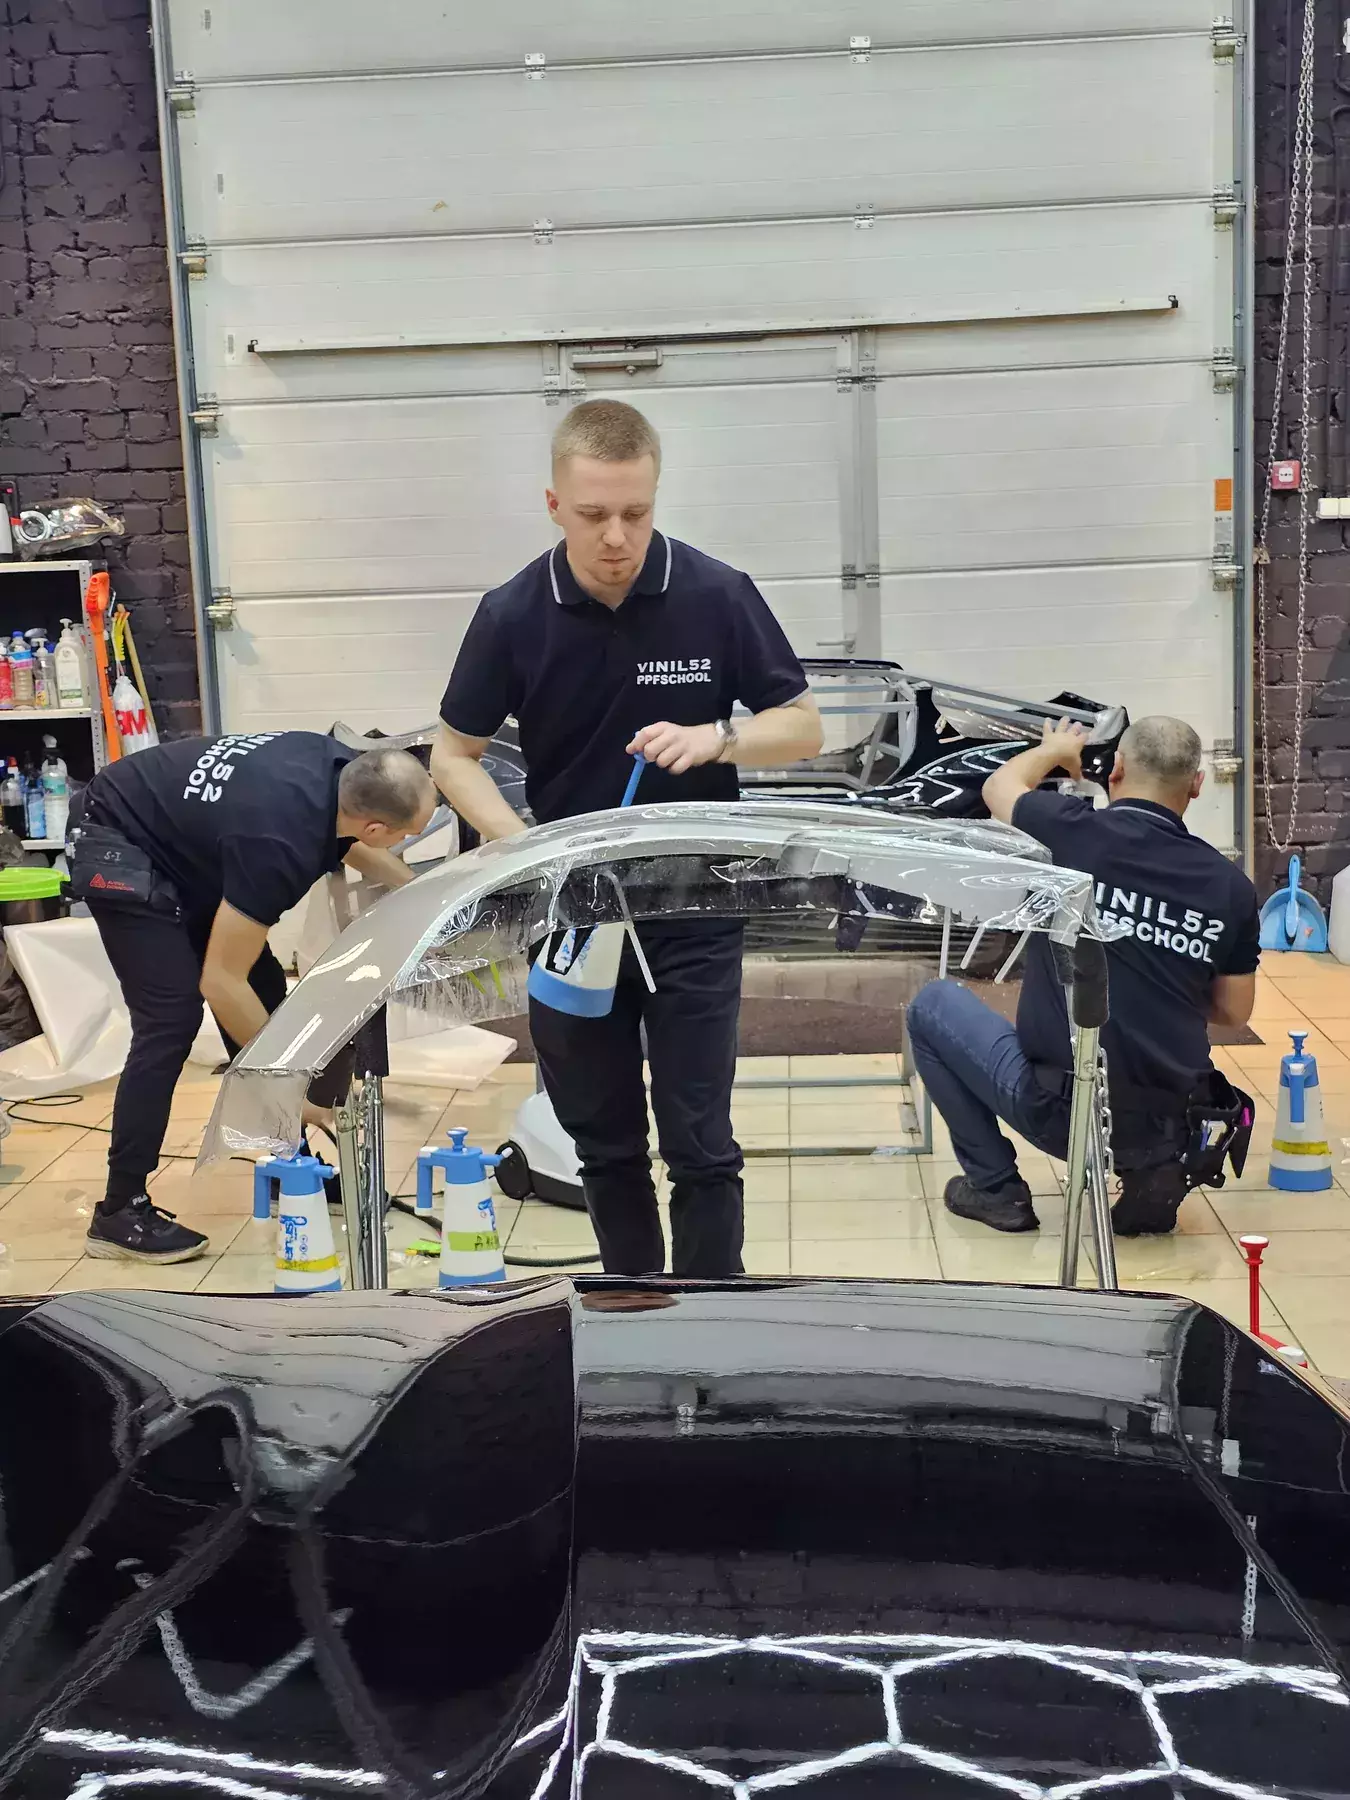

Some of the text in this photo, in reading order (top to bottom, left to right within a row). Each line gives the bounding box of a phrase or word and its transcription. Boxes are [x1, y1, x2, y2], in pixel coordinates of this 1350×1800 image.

[636, 672, 711, 685] PPFSCHOOL
[637, 658, 711, 673] VINIL52
[200, 731, 288, 803] INIL52
[1094, 881, 1225, 942] INIL52
[1095, 908, 1213, 963] FSCHOOL
